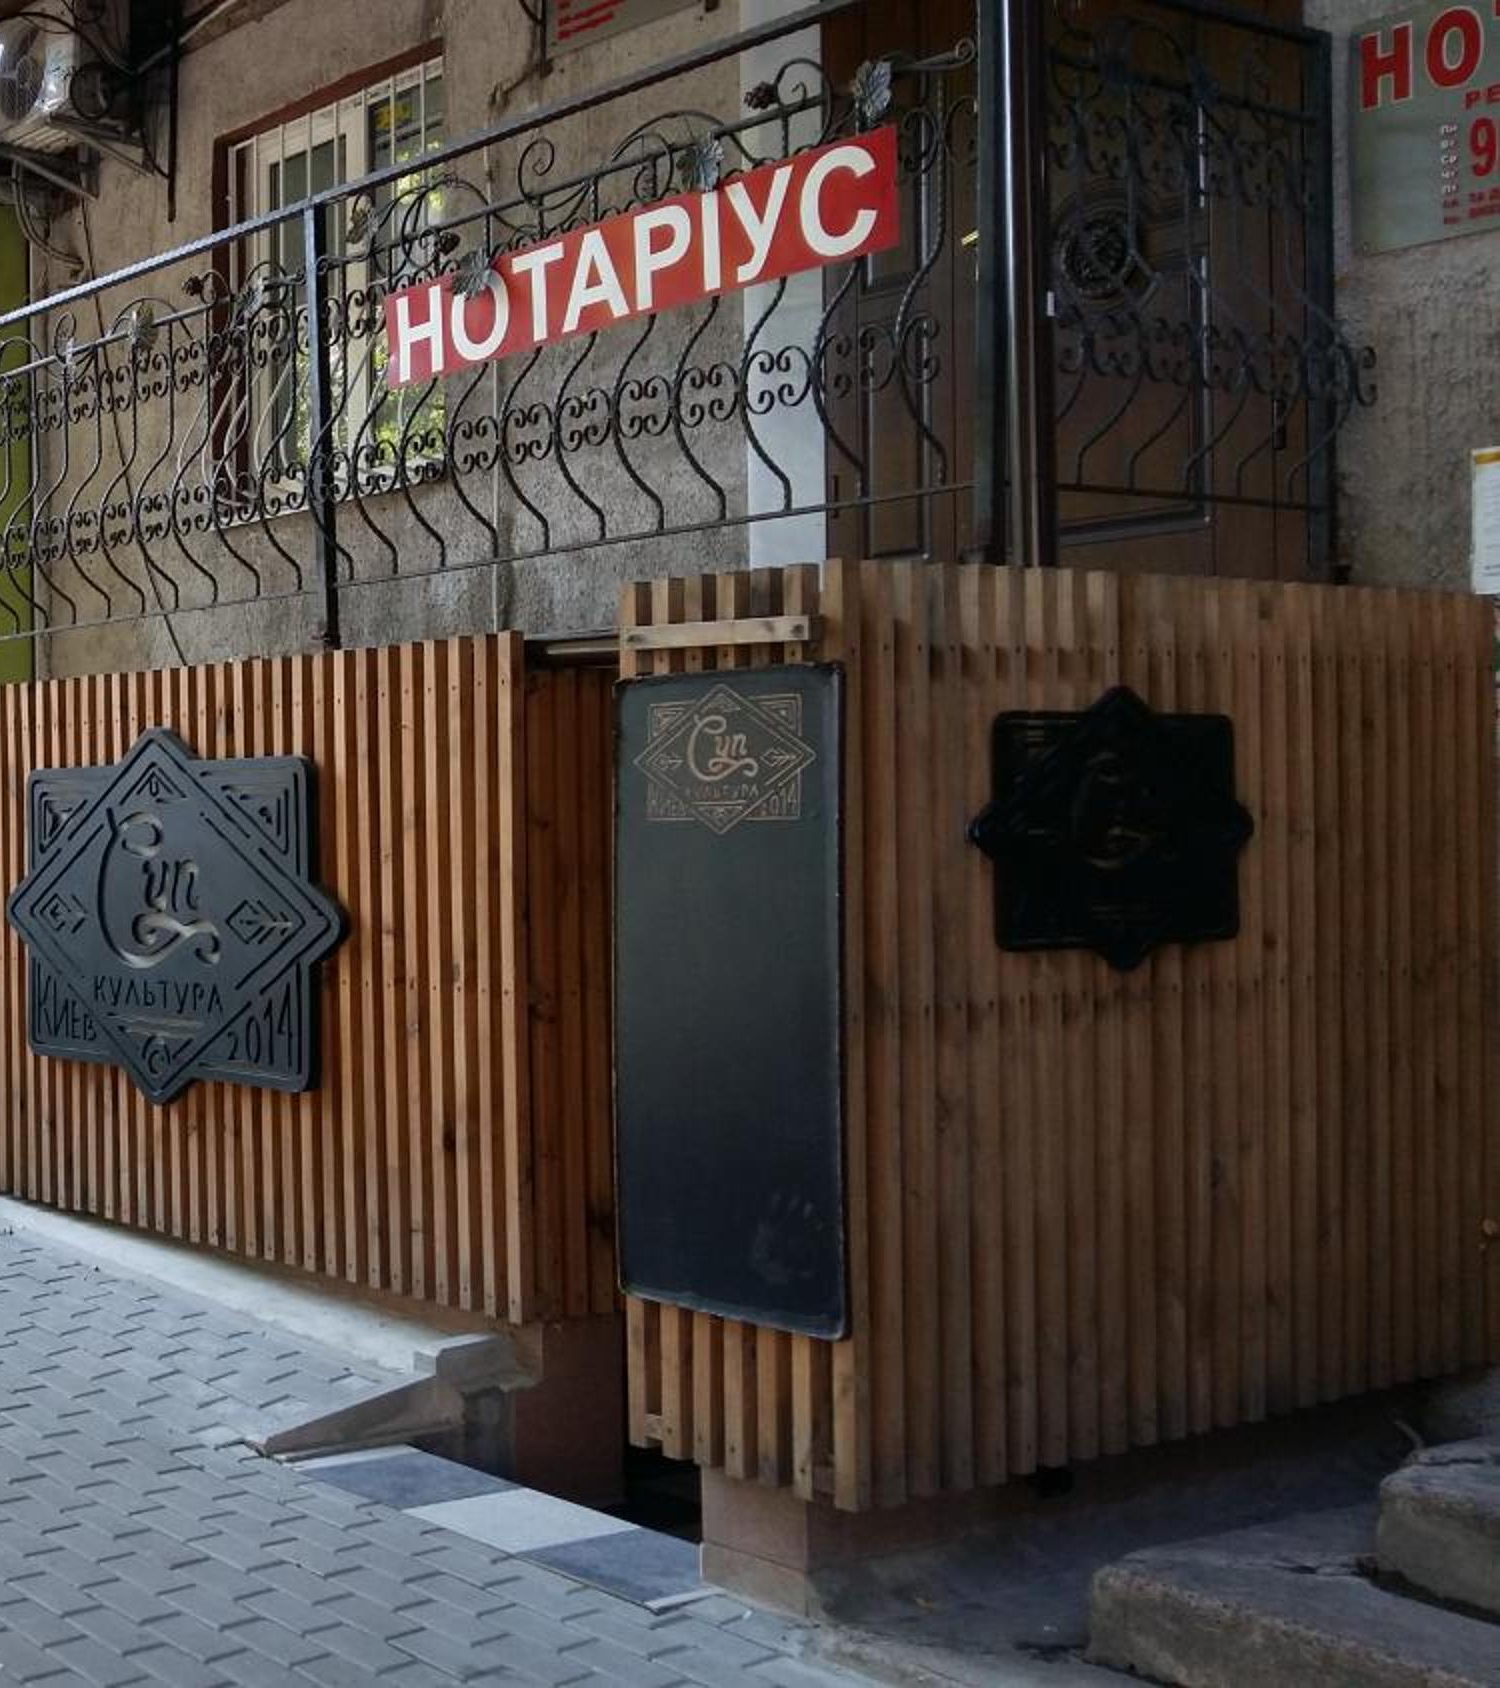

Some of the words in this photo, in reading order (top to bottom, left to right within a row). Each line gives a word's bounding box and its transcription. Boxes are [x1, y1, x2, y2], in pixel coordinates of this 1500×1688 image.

[1359, 0, 1500, 111] НО
[394, 144, 877, 383] НОТАРІУС
[36, 968, 97, 1042] КИЕВ
[227, 982, 294, 1069] 2014
[92, 975, 224, 1015] КУЛЬТУРА
